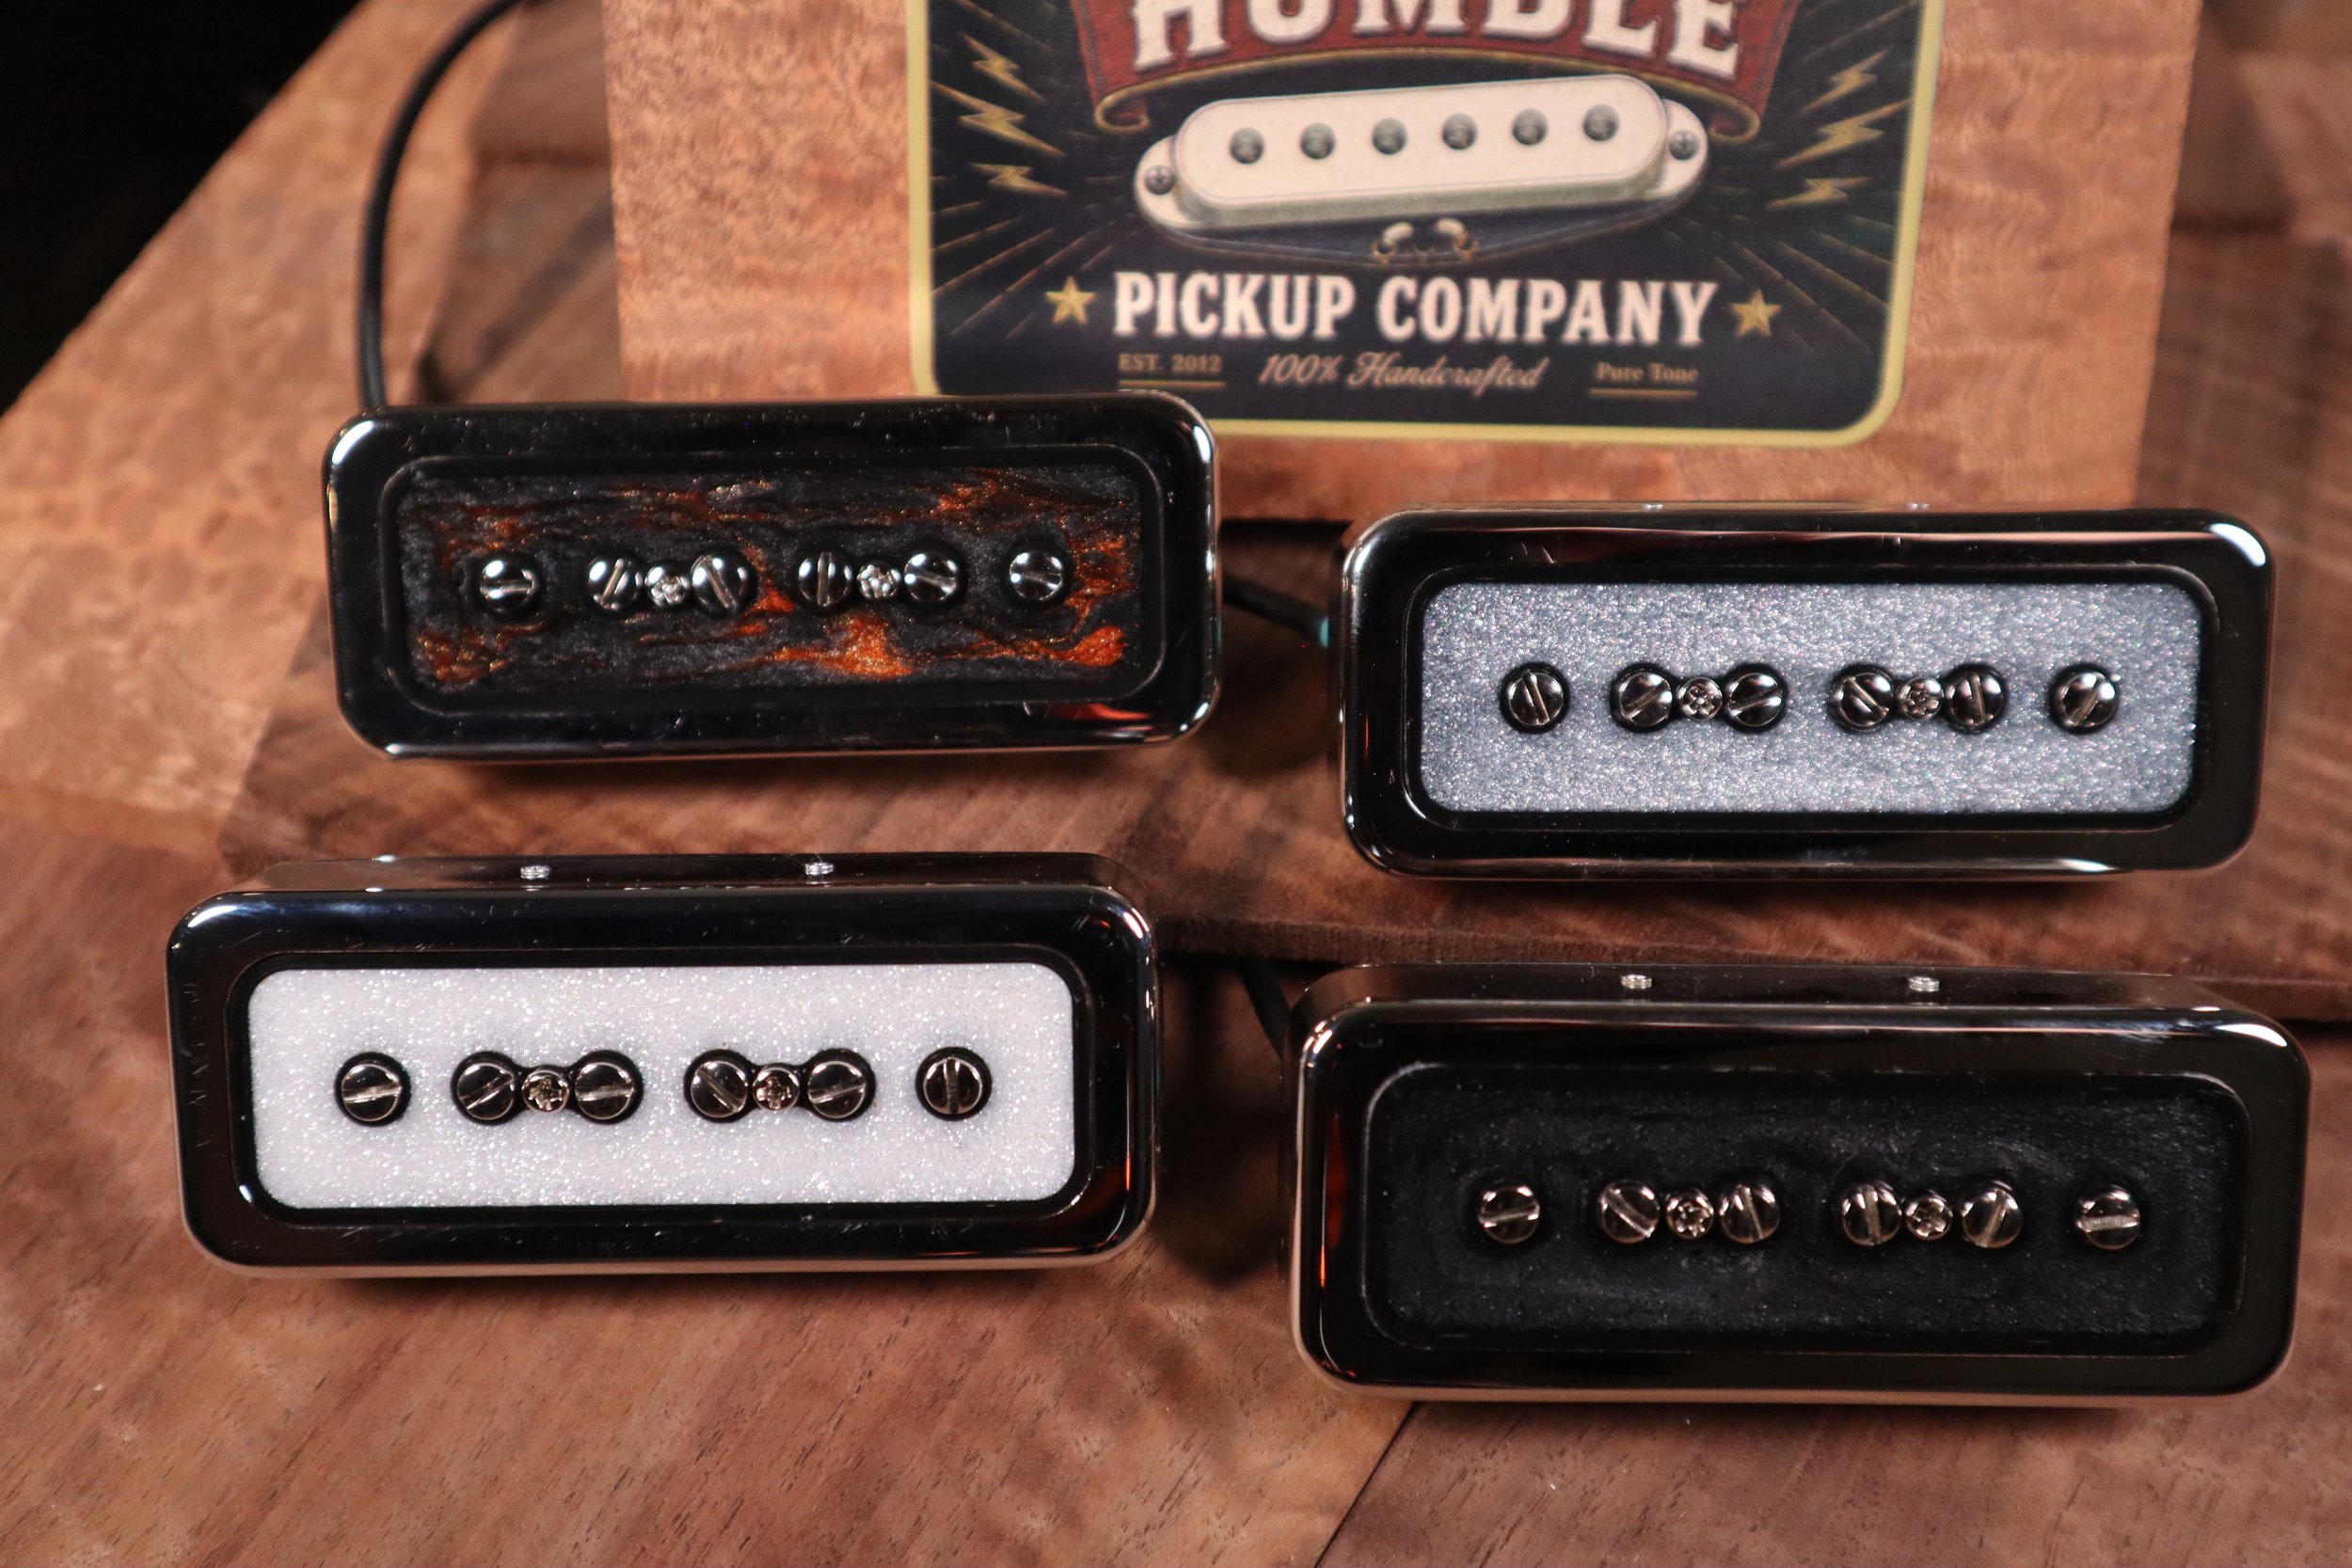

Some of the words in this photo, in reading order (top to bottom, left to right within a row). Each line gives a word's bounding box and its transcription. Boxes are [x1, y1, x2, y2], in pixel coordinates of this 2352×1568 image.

[1113, 272, 1355, 339] PICKUP
[1377, 277, 1717, 344] COMPANY
[1118, 353, 1163, 372] EST.
[1172, 354, 1222, 373] 2012
[1258, 354, 1343, 386] 100%
[1345, 351, 1550, 398] Handcrafted
[1596, 362, 1644, 382] Pure
[1650, 363, 1699, 384] Tone
